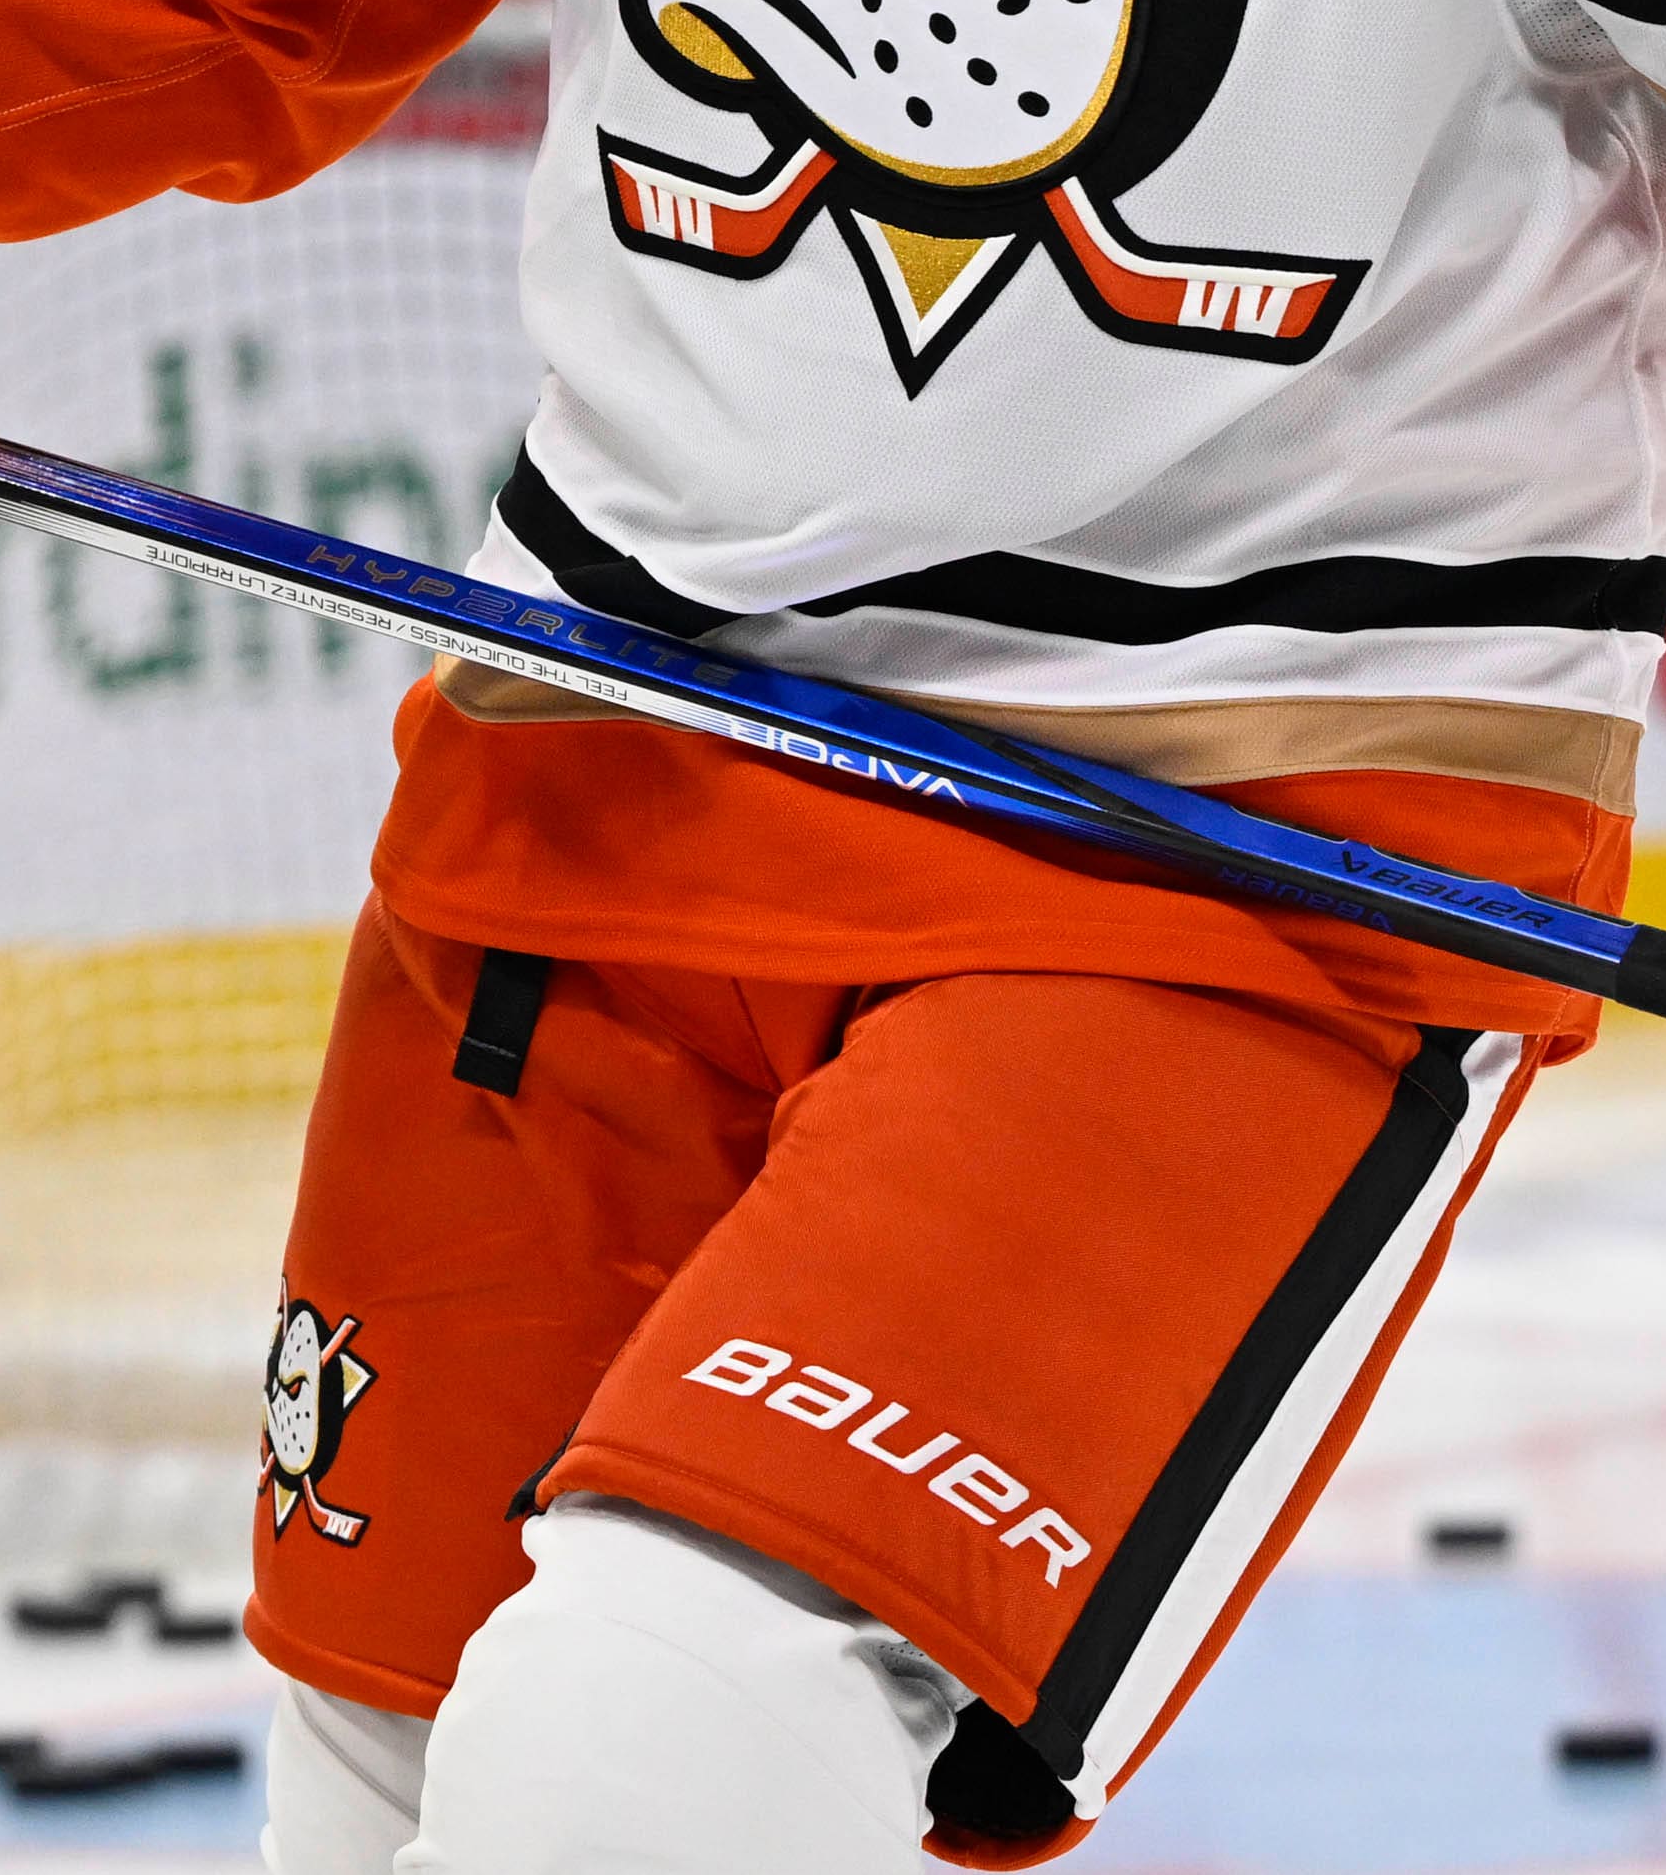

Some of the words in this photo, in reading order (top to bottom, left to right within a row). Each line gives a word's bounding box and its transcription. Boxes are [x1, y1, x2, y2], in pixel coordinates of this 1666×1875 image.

[145, 544, 233, 582] RAPIDITÉ
[237, 571, 266, 589] LA
[270, 583, 391, 630] RESSENTEZ
[409, 624, 524, 671] QUICKNESS
[531, 661, 571, 685] THE
[576, 673, 628, 702] FEEL
[1365, 866, 1555, 930] BAUER
[681, 1338, 1091, 1589] BAUER
